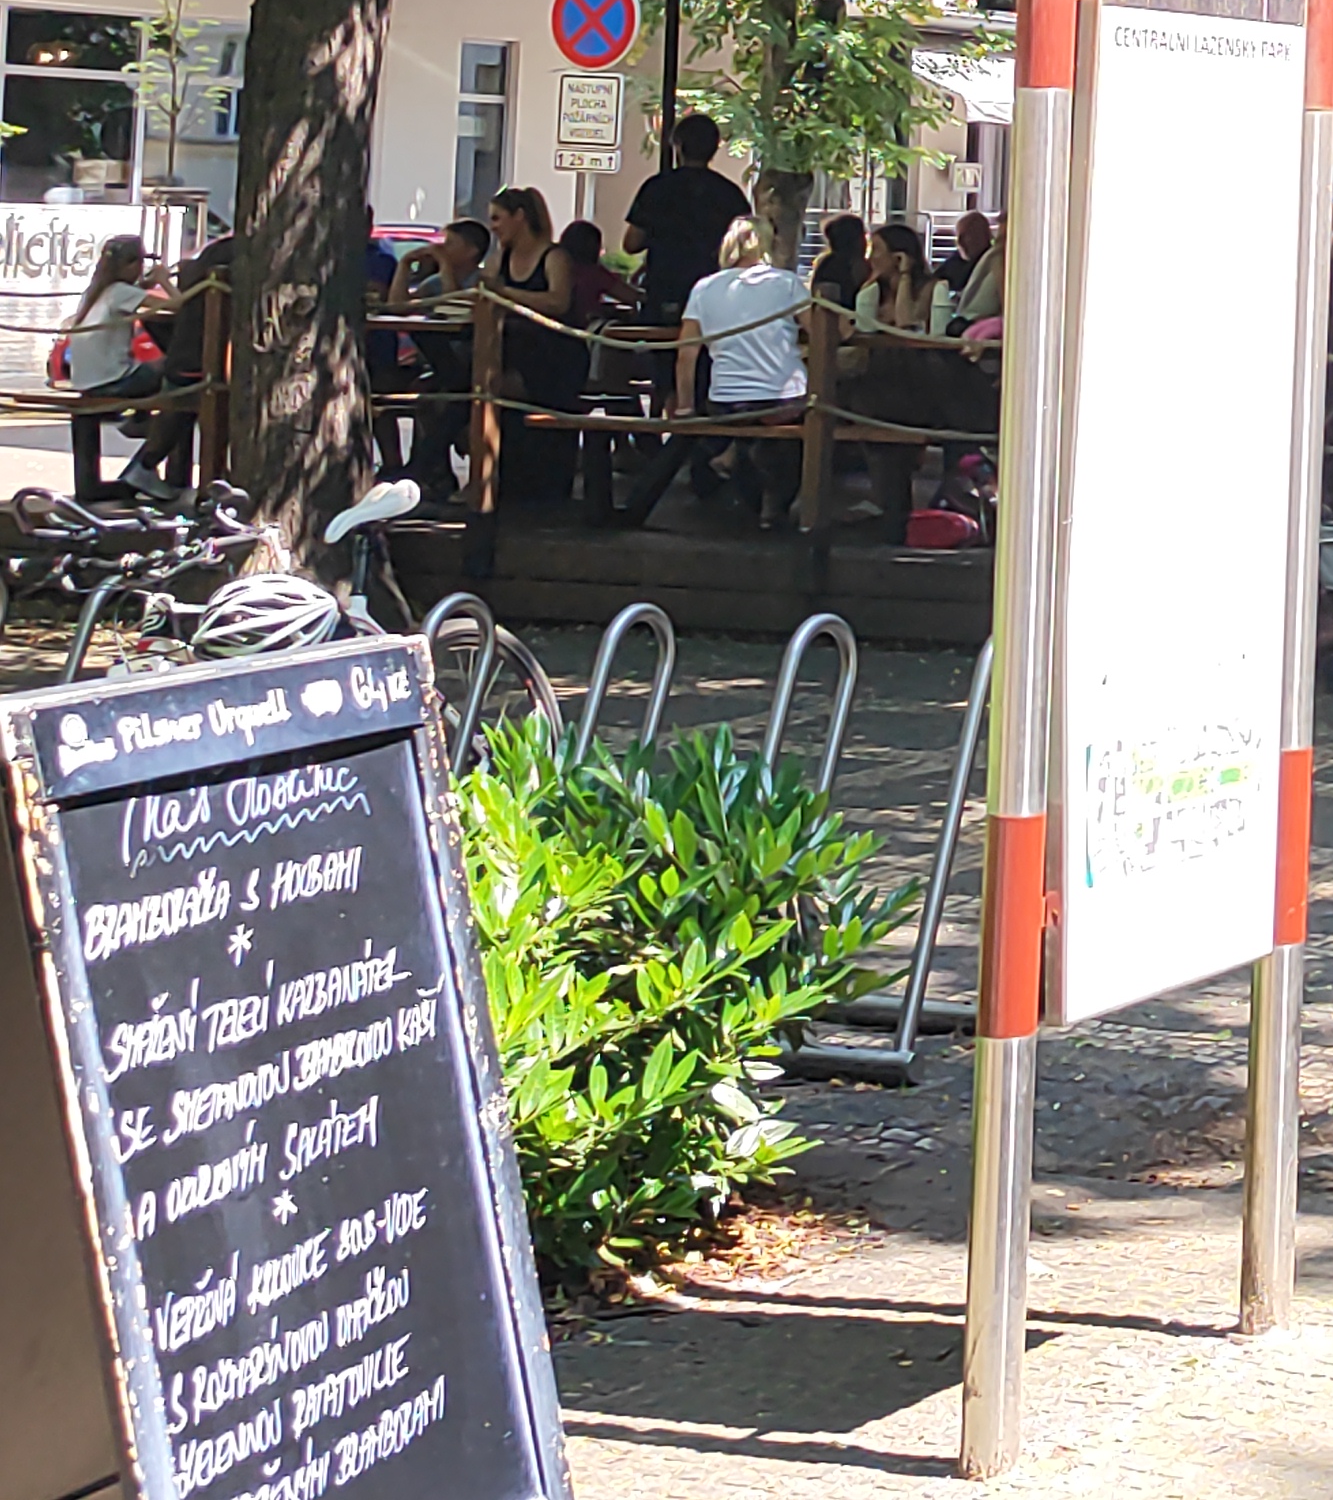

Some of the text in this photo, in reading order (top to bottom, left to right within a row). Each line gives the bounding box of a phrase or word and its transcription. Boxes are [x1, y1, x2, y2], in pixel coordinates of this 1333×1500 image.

[569, 153, 602, 167] 25 m
[0, 212, 95, 278] licita
[117, 713, 203, 753] Pilsner
[207, 687, 292, 746] Urquell
[239, 868, 261, 912] S
[137, 1191, 156, 1241] A
